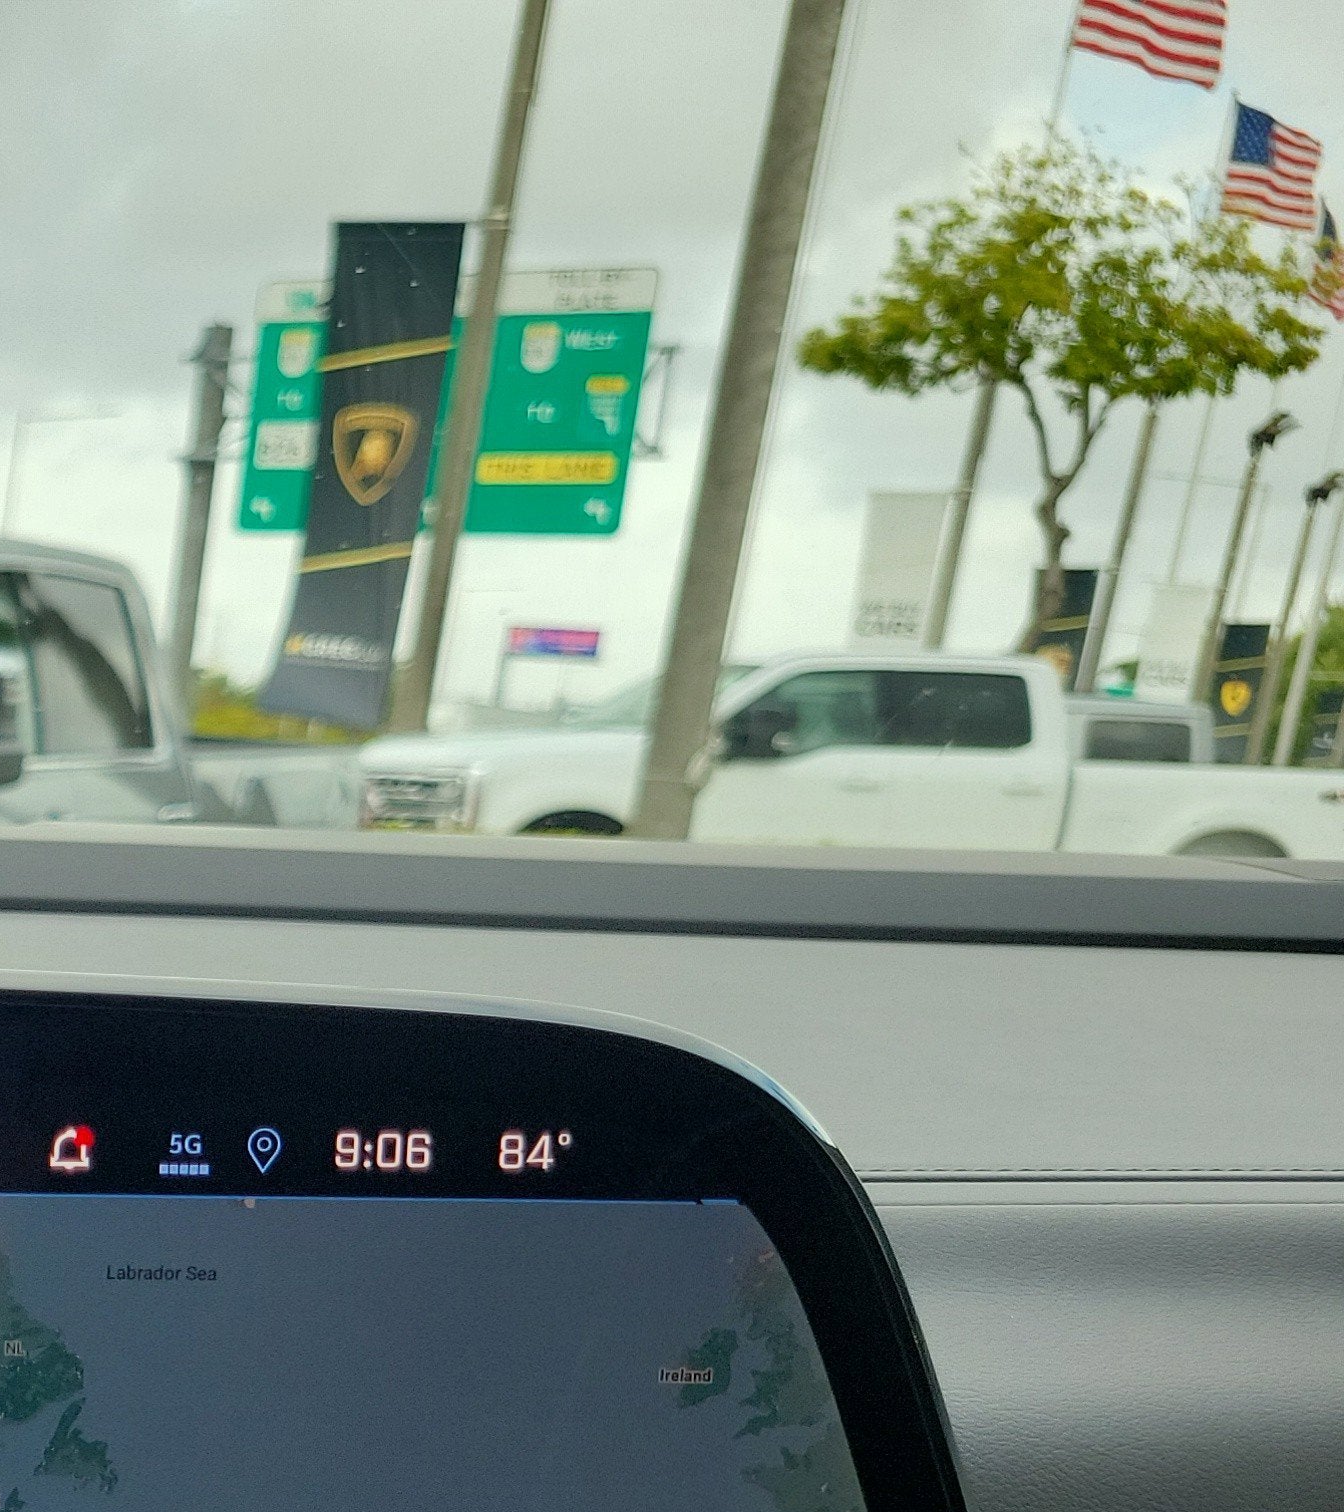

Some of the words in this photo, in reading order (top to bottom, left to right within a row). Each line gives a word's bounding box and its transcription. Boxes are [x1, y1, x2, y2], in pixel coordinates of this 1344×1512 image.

[168, 1134, 202, 1156] 5G
[334, 1131, 432, 1170] 9:06
[106, 1265, 182, 1282] Labrador
[187, 1266, 218, 1282] Sea
[5, 1341, 24, 1356] NL
[660, 1368, 712, 1384] Ireland
